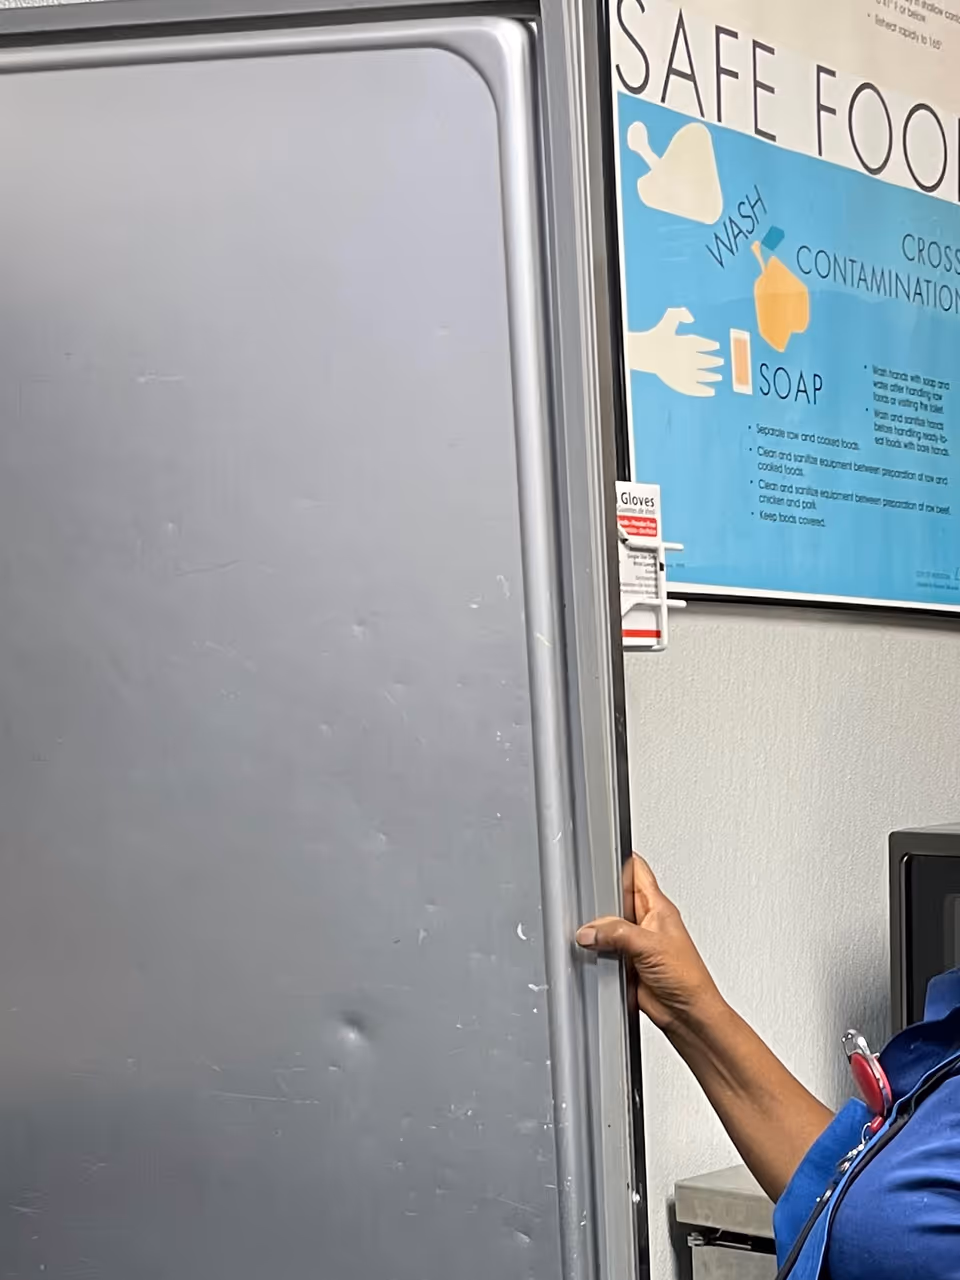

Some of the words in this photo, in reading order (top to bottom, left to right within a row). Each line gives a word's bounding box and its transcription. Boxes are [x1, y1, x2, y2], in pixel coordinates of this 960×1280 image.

[615, 0, 777, 142] SAFE
[705, 184, 768, 270] WASH
[759, 363, 823, 405] SOAP
[621, 492, 655, 508] Gloves
